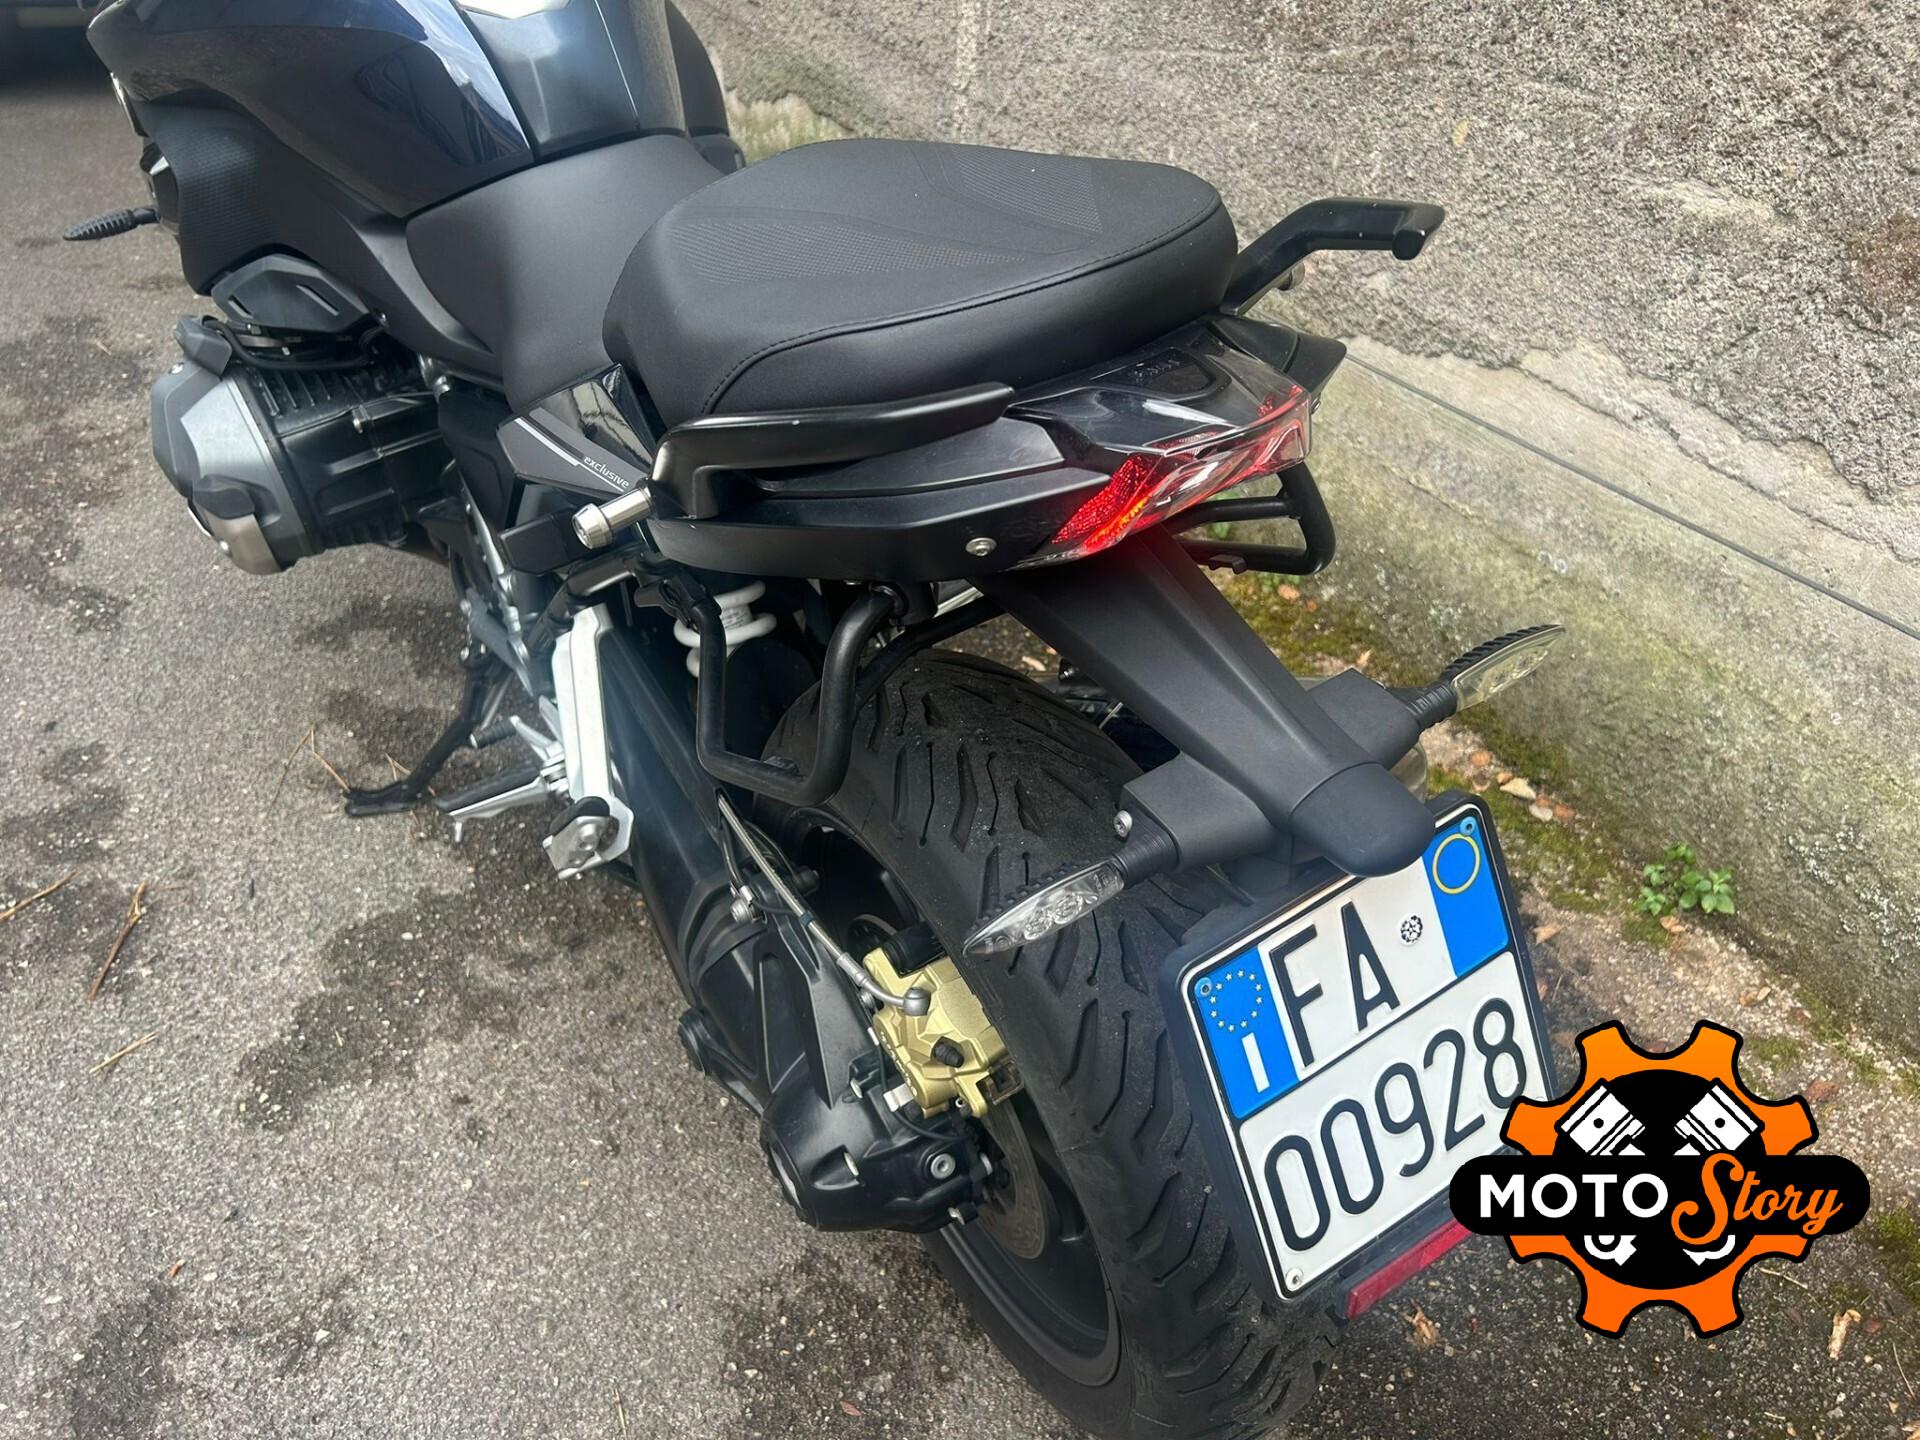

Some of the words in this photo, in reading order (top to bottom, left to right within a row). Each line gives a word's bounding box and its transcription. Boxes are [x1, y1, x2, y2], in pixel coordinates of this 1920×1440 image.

[583, 455, 629, 489] exclusive
[1269, 901, 1399, 1068] FA
[1241, 1033, 1271, 1093] I
[1263, 997, 1527, 1252] 00928
